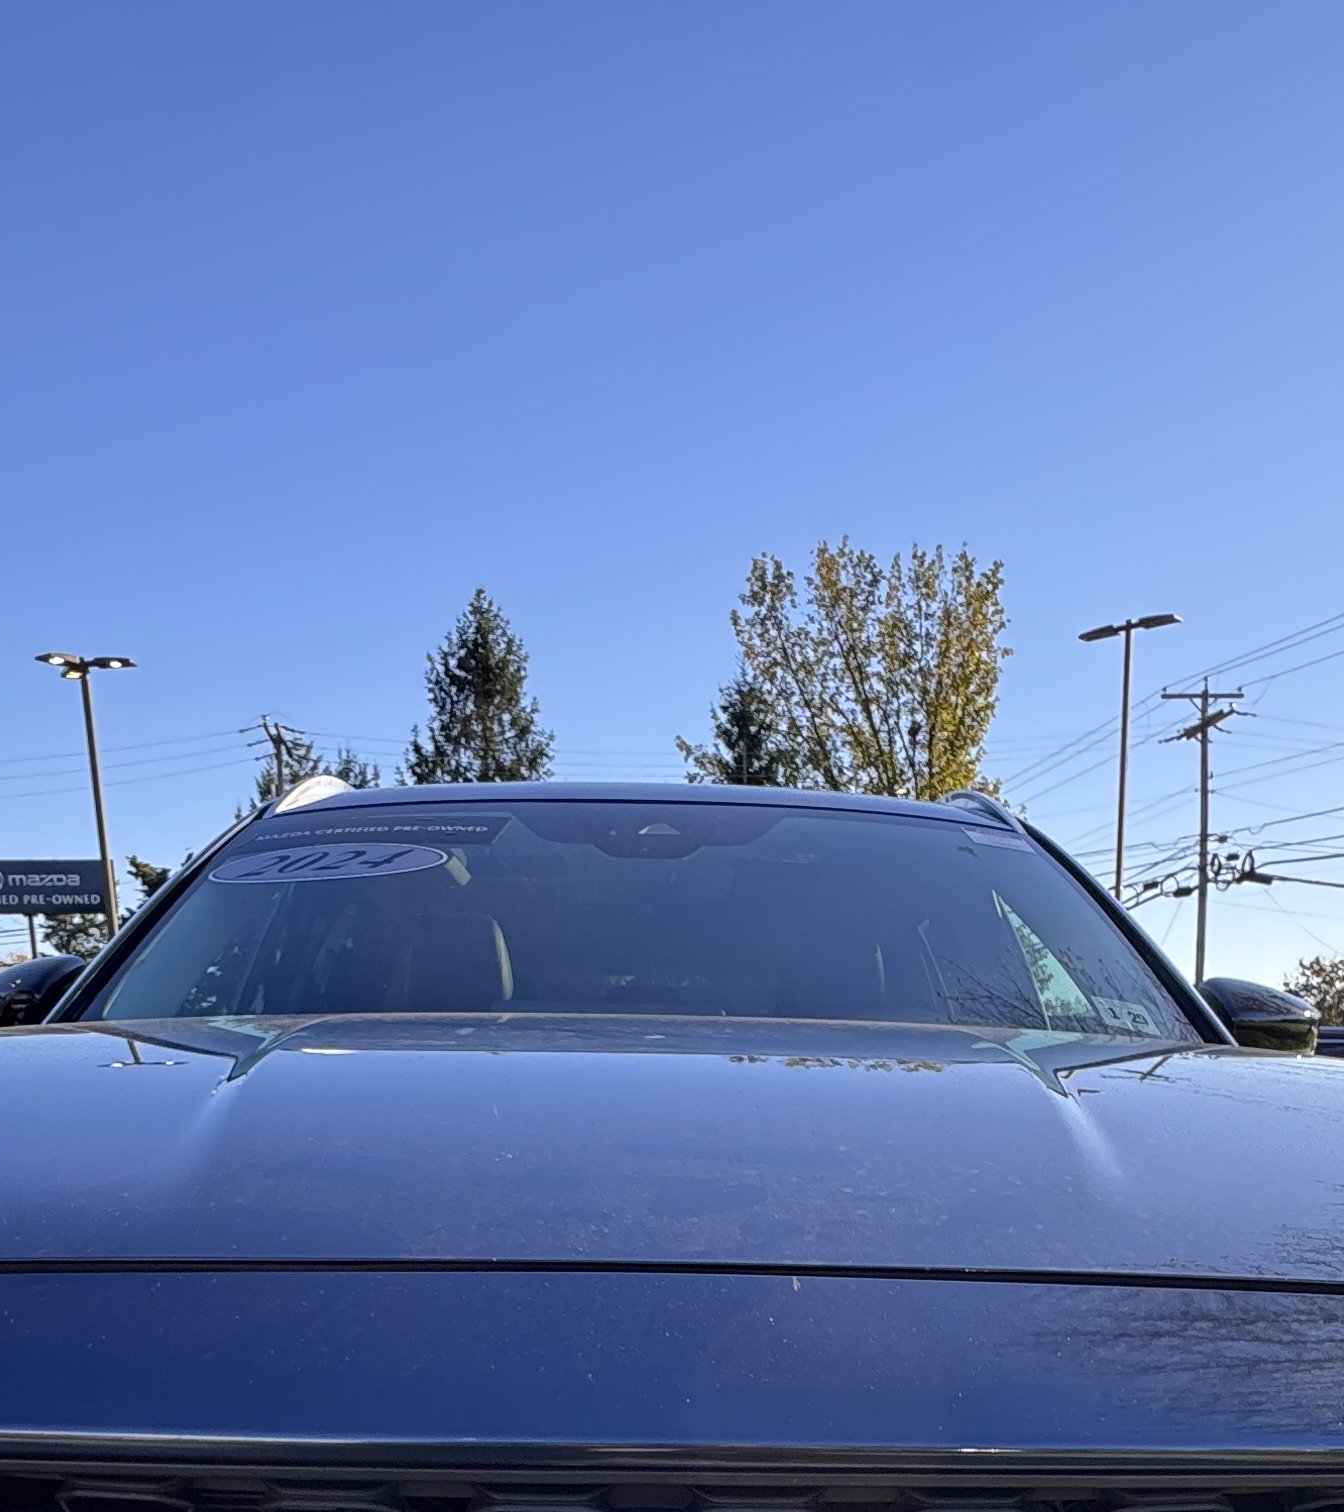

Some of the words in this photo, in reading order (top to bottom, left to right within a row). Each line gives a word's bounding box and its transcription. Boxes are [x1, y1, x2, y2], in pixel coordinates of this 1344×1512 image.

[314, 825, 390, 836] CERTIFIED
[234, 848, 416, 878] 2024
[7, 874, 81, 887] mazda
[23, 894, 101, 906] PRE-OWNED
